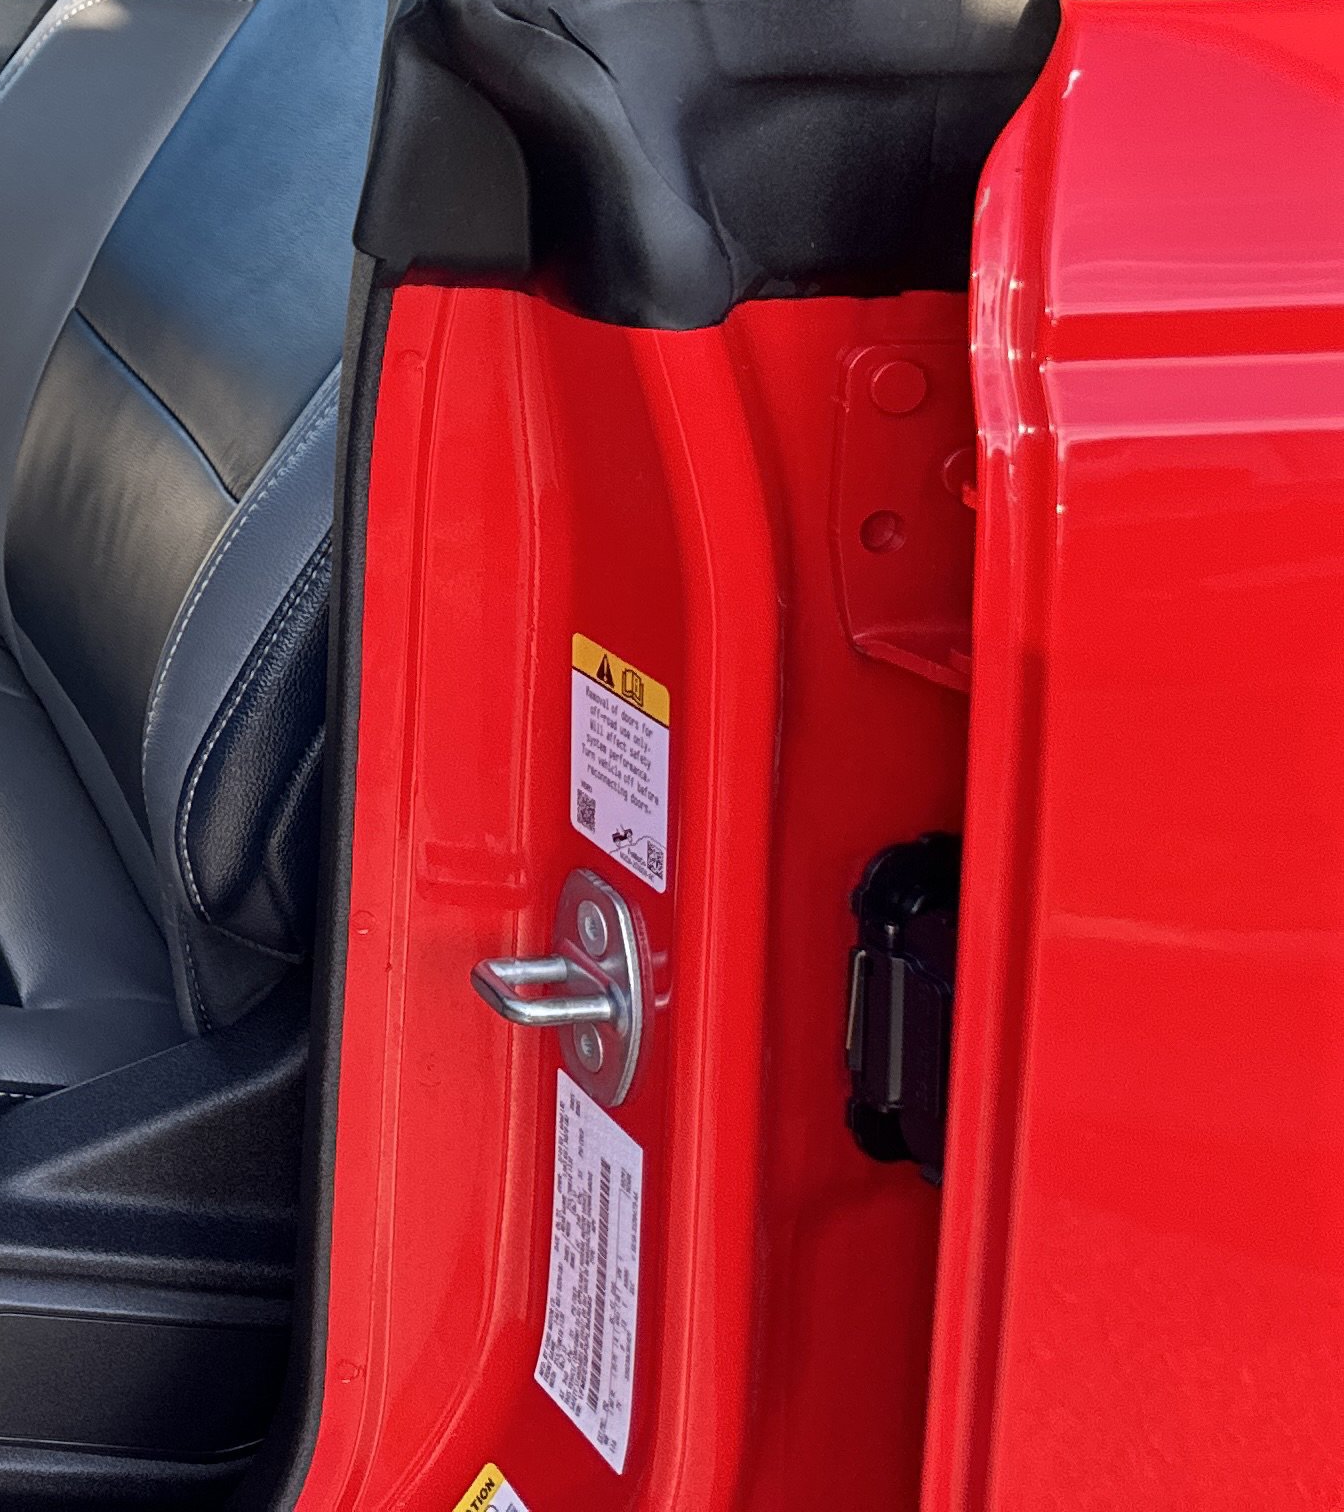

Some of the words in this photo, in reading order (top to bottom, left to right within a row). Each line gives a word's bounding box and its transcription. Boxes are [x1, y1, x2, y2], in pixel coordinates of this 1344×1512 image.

[586, 686, 609, 710] Removal
[611, 705, 618, 715] of
[621, 710, 639, 731] doors
[642, 723, 653, 737] for
[590, 706, 618, 731] off-road
[620, 727, 631, 740] use
[586, 734, 606, 754] system
[590, 720, 603, 736] Will
[606, 731, 627, 752] affect
[630, 746, 651, 770] safety
[582, 742, 595, 760] Turn
[598, 756, 622, 779] vehicle
[624, 774, 634, 787] off
[637, 780, 659, 806] before
[587, 764, 628, 801] reconnecting
